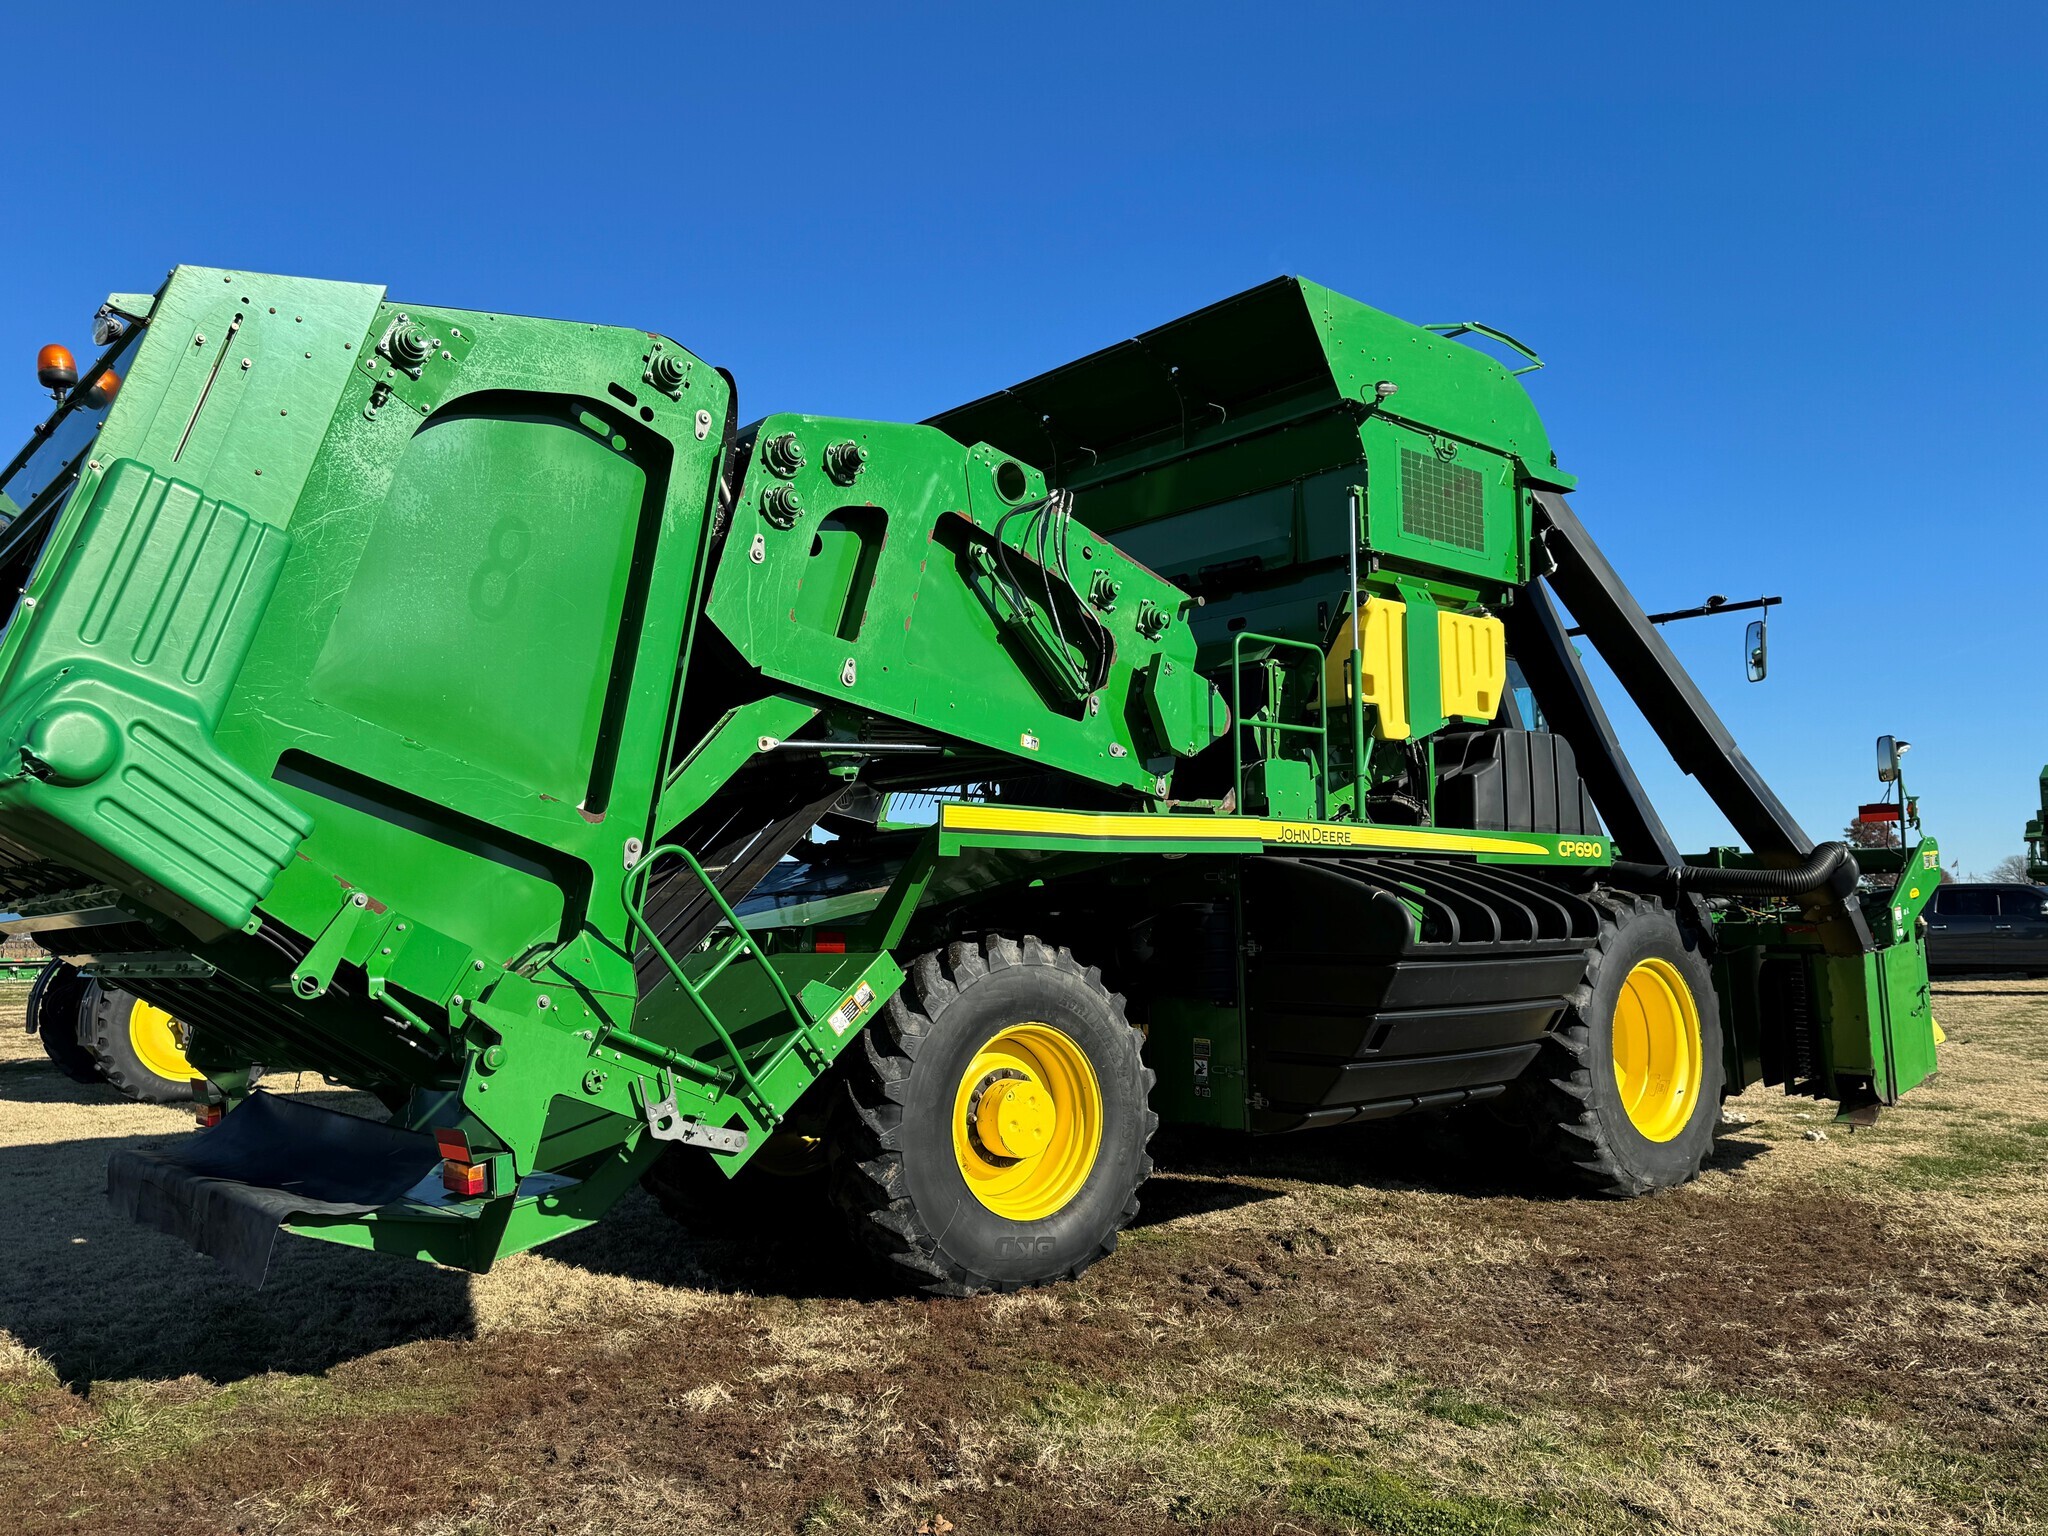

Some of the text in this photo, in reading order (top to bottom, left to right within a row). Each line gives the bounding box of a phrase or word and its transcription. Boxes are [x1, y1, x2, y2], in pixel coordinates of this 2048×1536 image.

[1277, 825, 1352, 843] JOHN DEERE
[1558, 840, 1602, 858] CP690
[993, 1236, 1057, 1261] BKT
